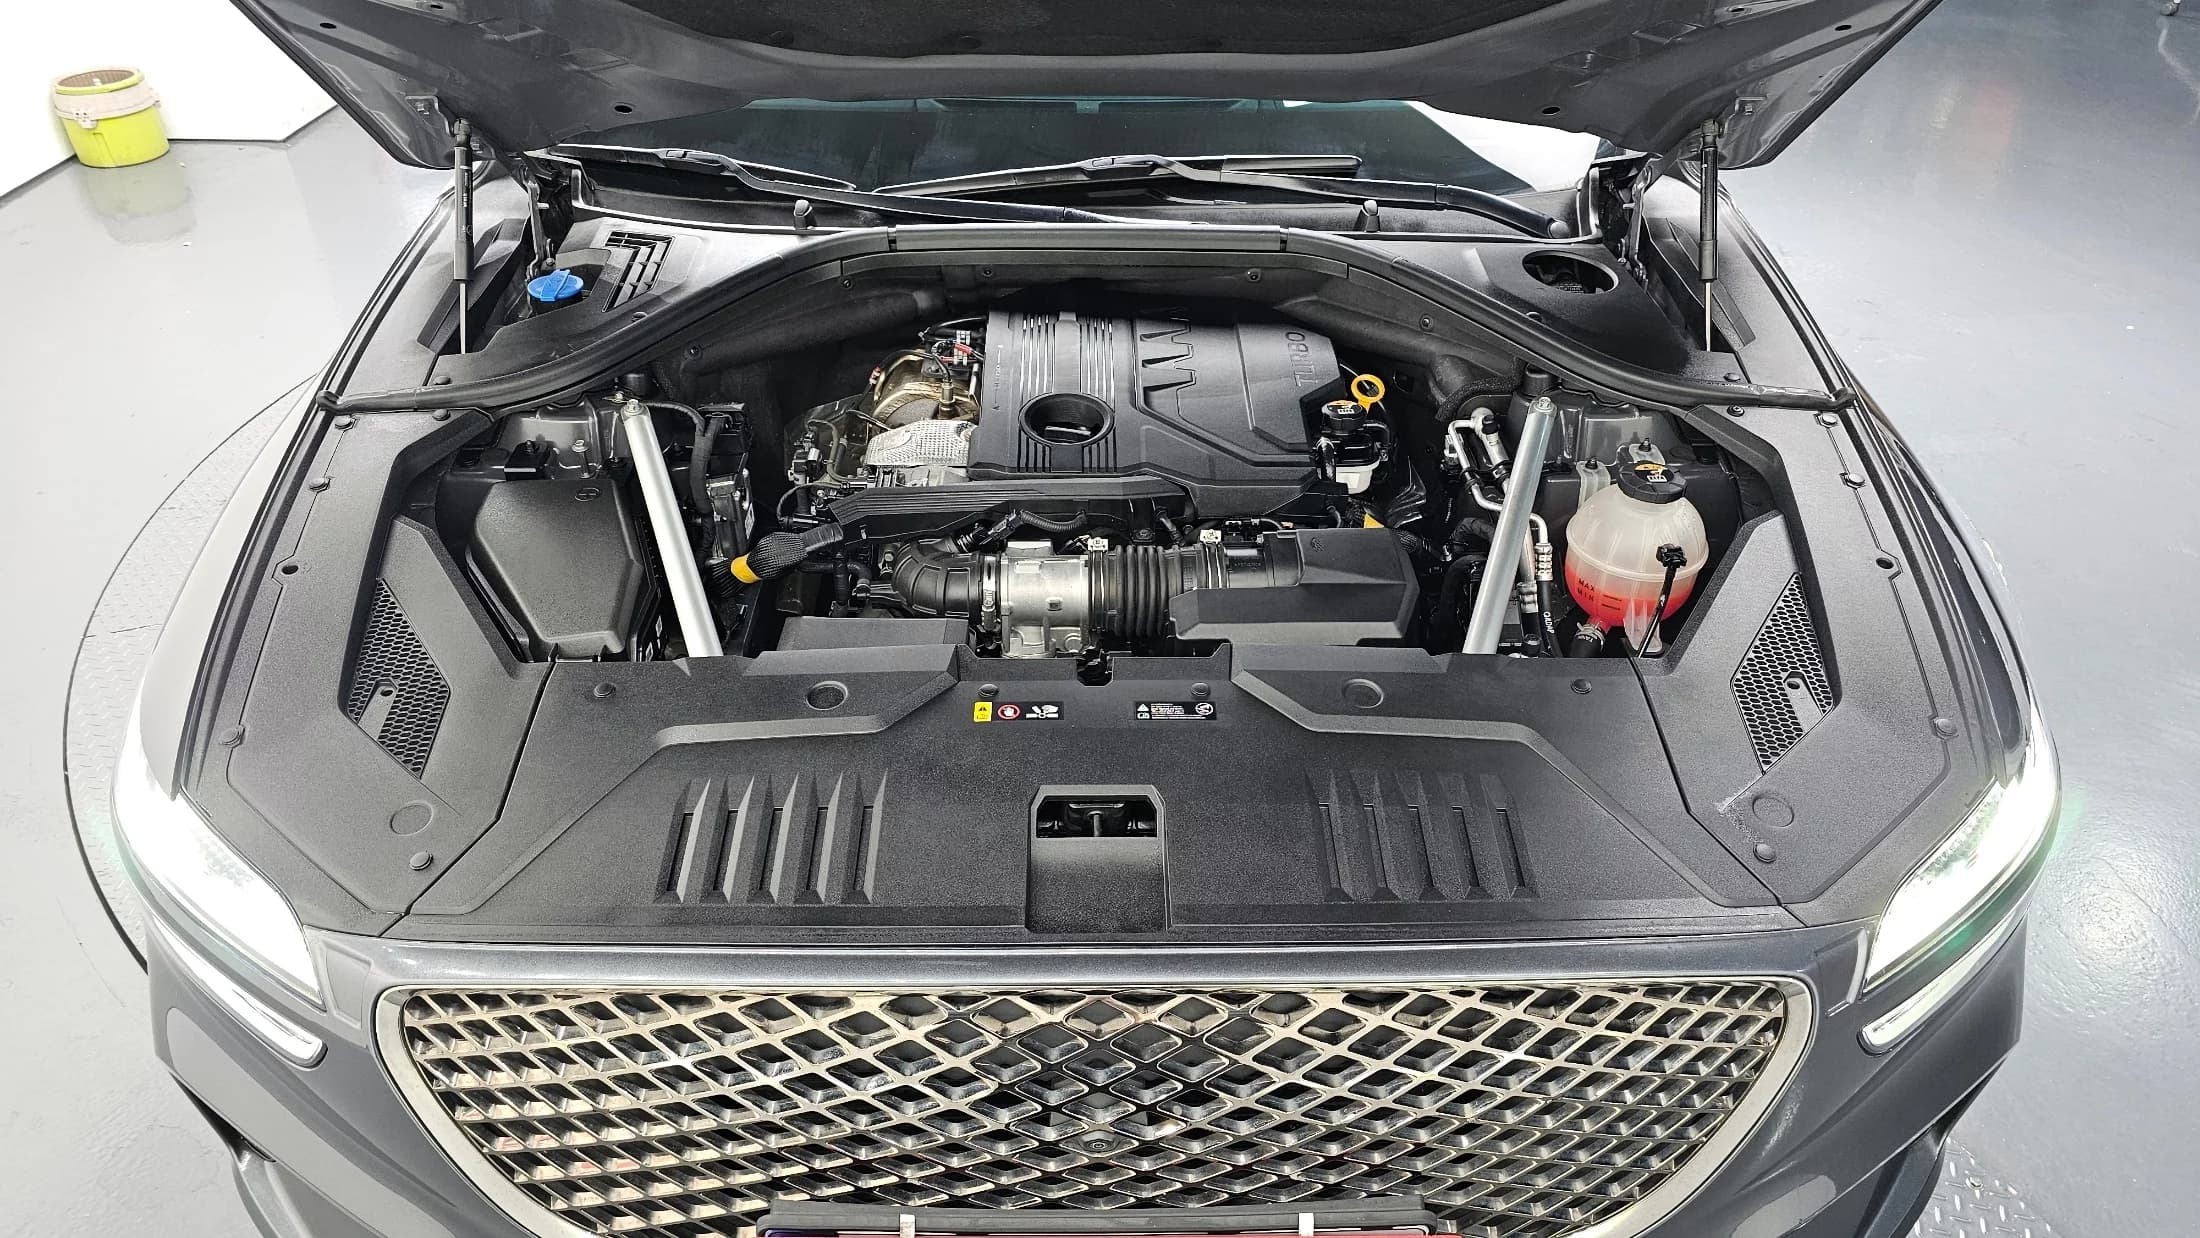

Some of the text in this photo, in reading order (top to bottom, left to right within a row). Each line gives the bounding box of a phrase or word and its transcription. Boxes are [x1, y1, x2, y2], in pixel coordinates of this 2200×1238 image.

[1285, 331, 1317, 387] TURBO
[1578, 577, 1595, 593] MAX
[1577, 587, 1594, 602] MIN
